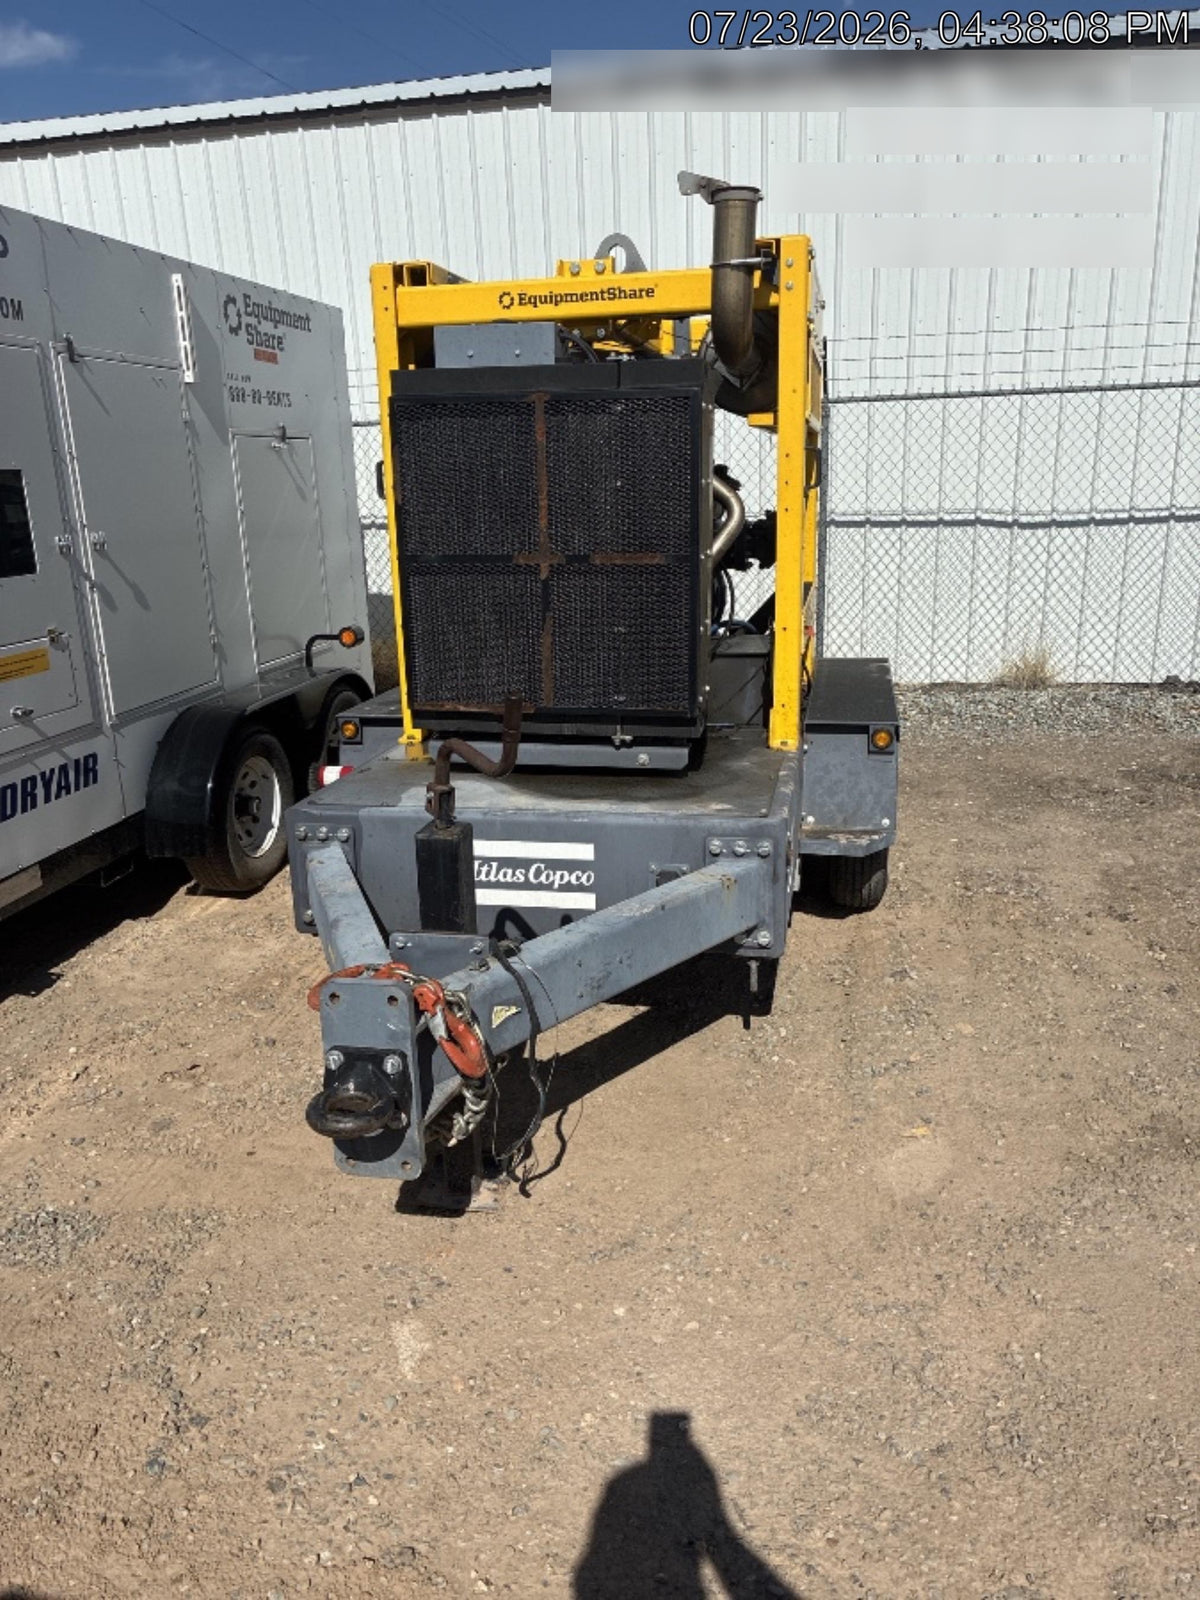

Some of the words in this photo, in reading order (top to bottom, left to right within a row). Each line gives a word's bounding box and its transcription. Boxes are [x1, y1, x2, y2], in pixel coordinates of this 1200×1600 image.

[517, 286, 655, 308] EquipmentShare
[243, 293, 312, 333] Equipment
[245, 322, 285, 352] Share
[0, 751, 98, 824] DRYAIR
[528, 863, 595, 889] Copco
